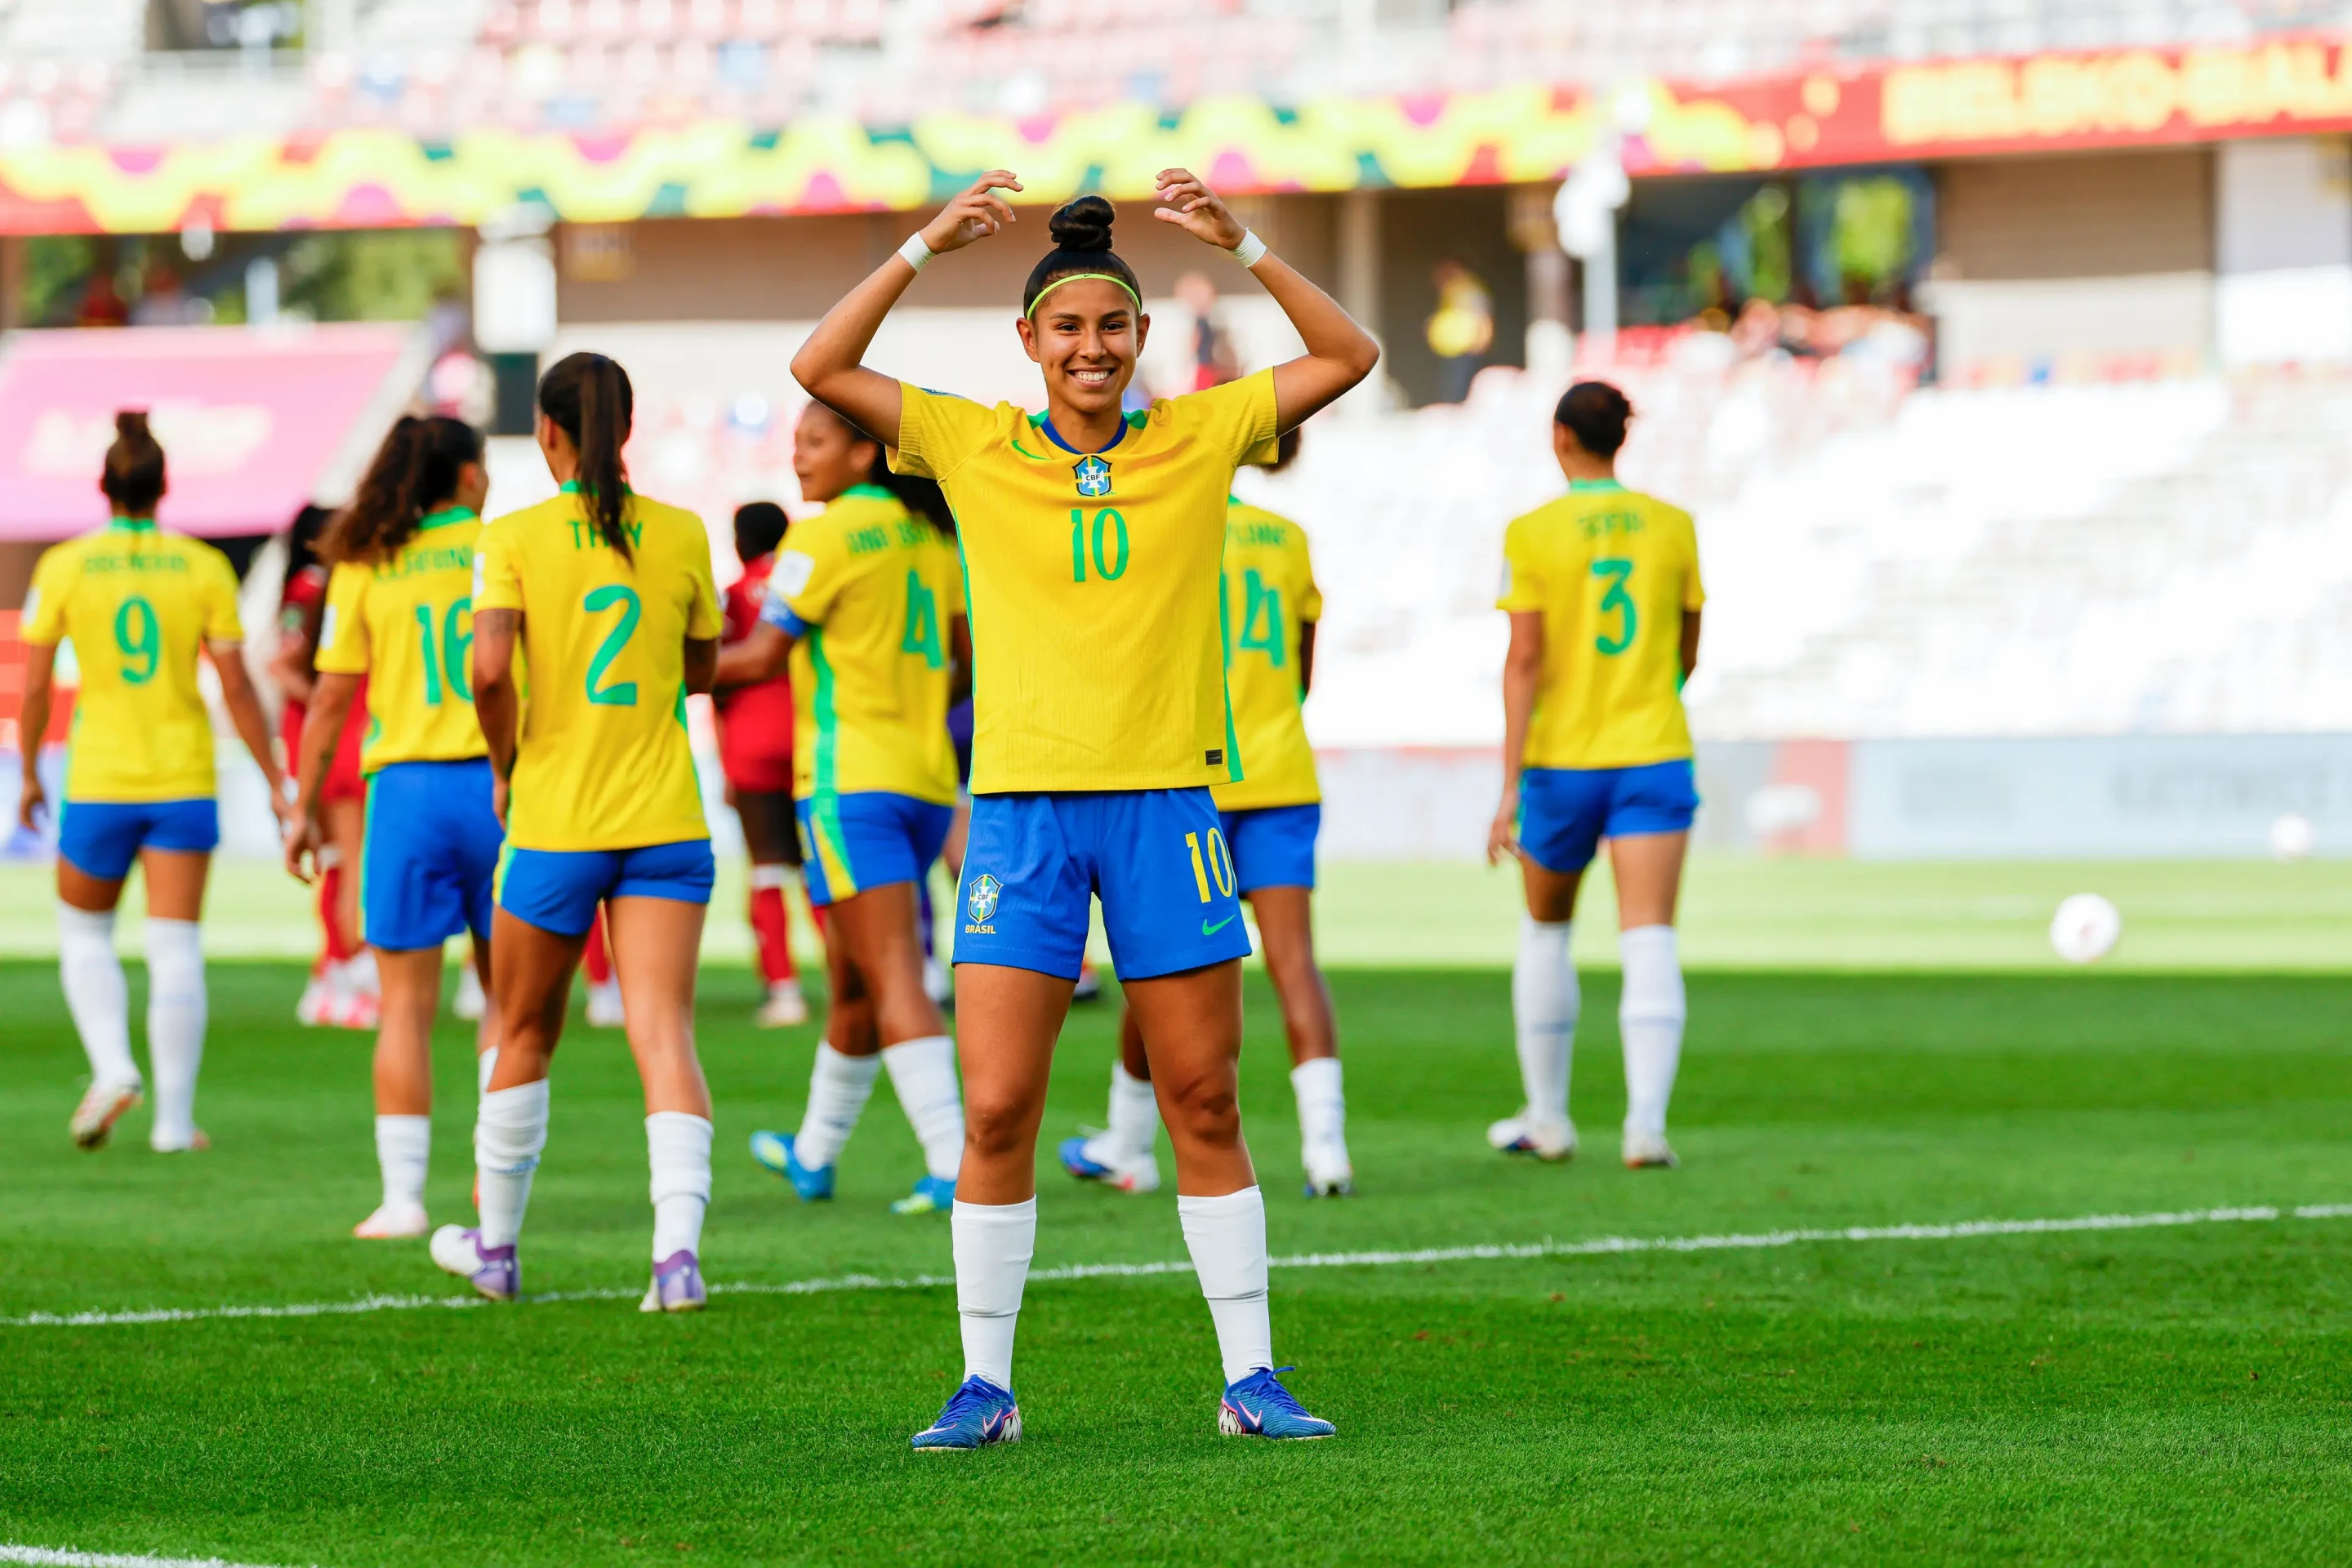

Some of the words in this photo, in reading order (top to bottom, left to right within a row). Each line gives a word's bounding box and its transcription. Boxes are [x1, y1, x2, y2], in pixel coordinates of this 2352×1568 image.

[1071, 507, 1129, 582] 10
[114, 595, 160, 684] 9
[415, 598, 474, 706] 16
[583, 584, 642, 706] 2
[902, 568, 944, 670] 4
[1592, 559, 1637, 656] 3
[1184, 827, 1232, 904] 10
[964, 924, 997, 935] BRASIL
